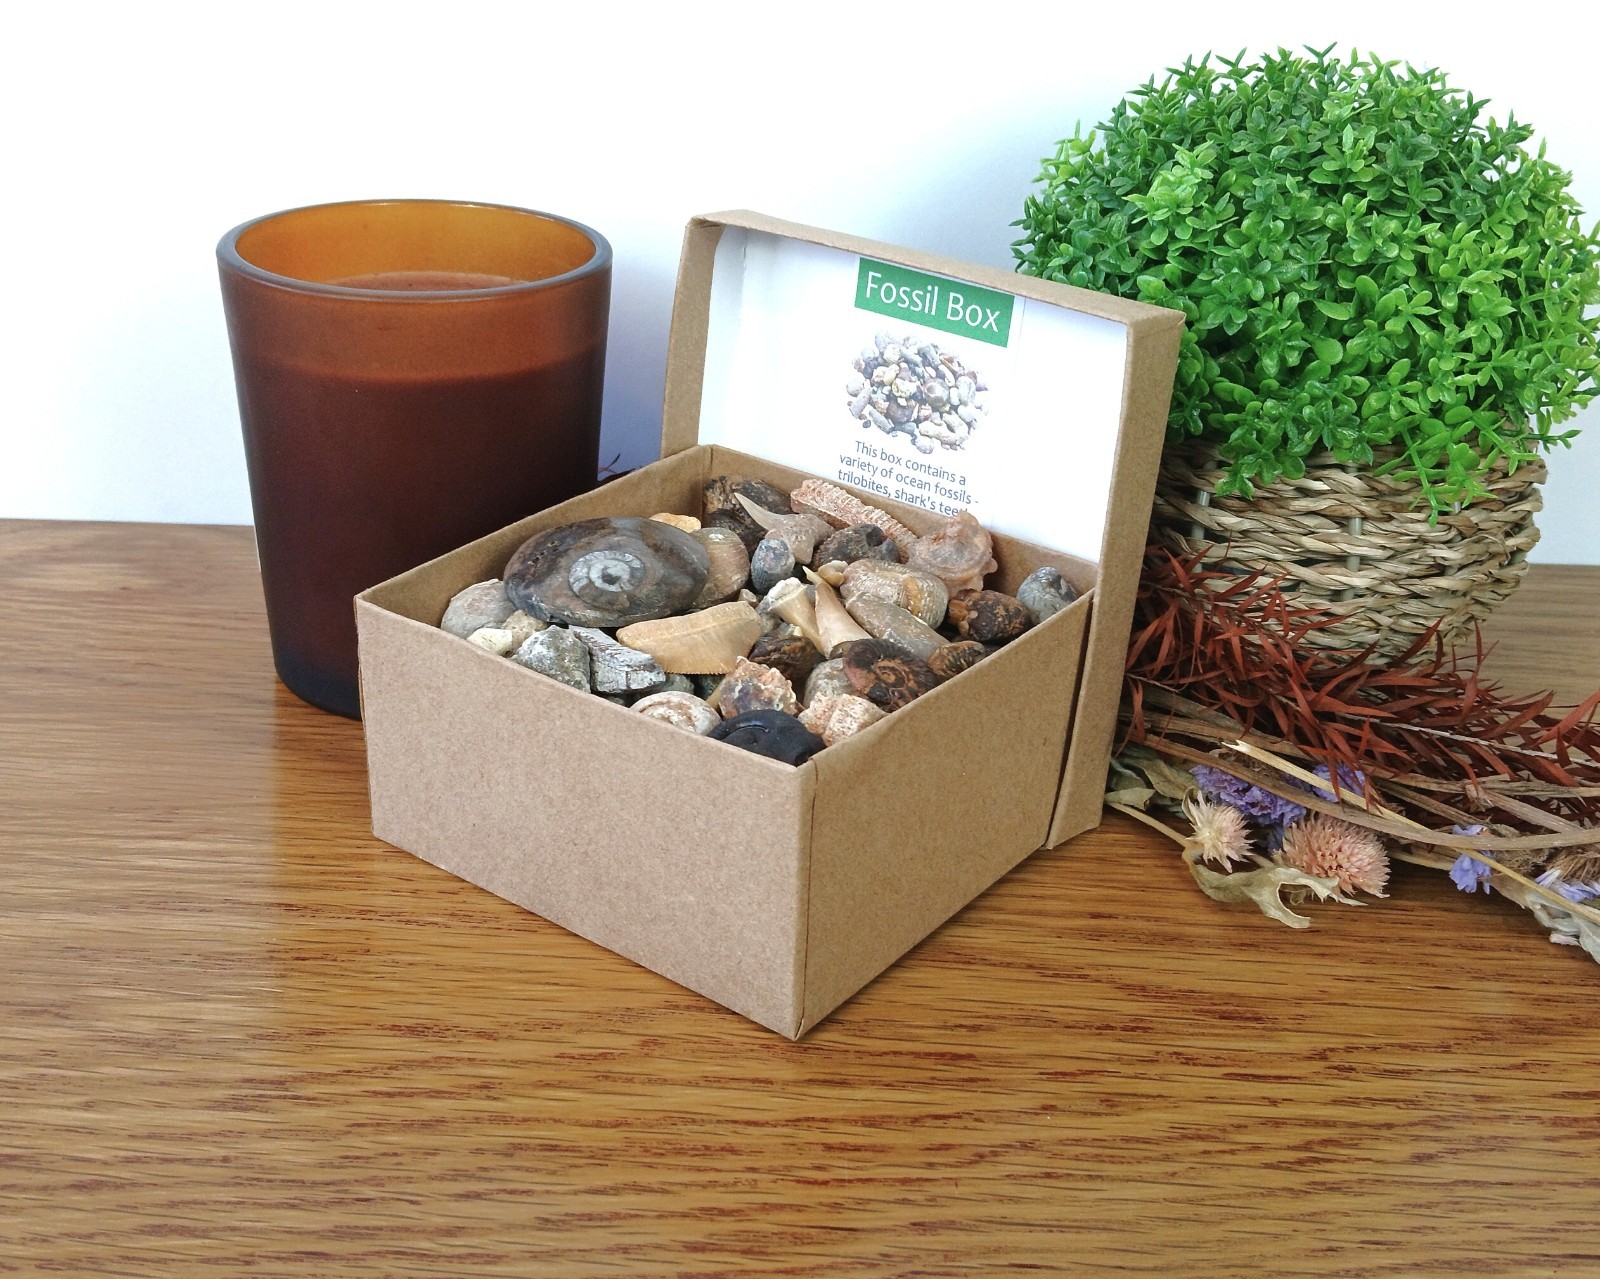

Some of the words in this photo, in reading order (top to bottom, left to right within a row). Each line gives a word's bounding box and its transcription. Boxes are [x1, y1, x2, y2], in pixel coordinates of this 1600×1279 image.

[865, 271, 939, 316] Fossil
[946, 292, 1001, 333] Box
[839, 454, 879, 477] variety
[880, 467, 894, 479] of
[895, 473, 931, 492] ocean
[934, 482, 972, 505] fossils
[855, 440, 878, 458] This
[880, 448, 902, 466] box
[905, 459, 956, 483] contains
[958, 475, 966, 486] a
[838, 469, 891, 498] trilobites,
[894, 488, 936, 511] shark's
[939, 502, 968, 517] tee
